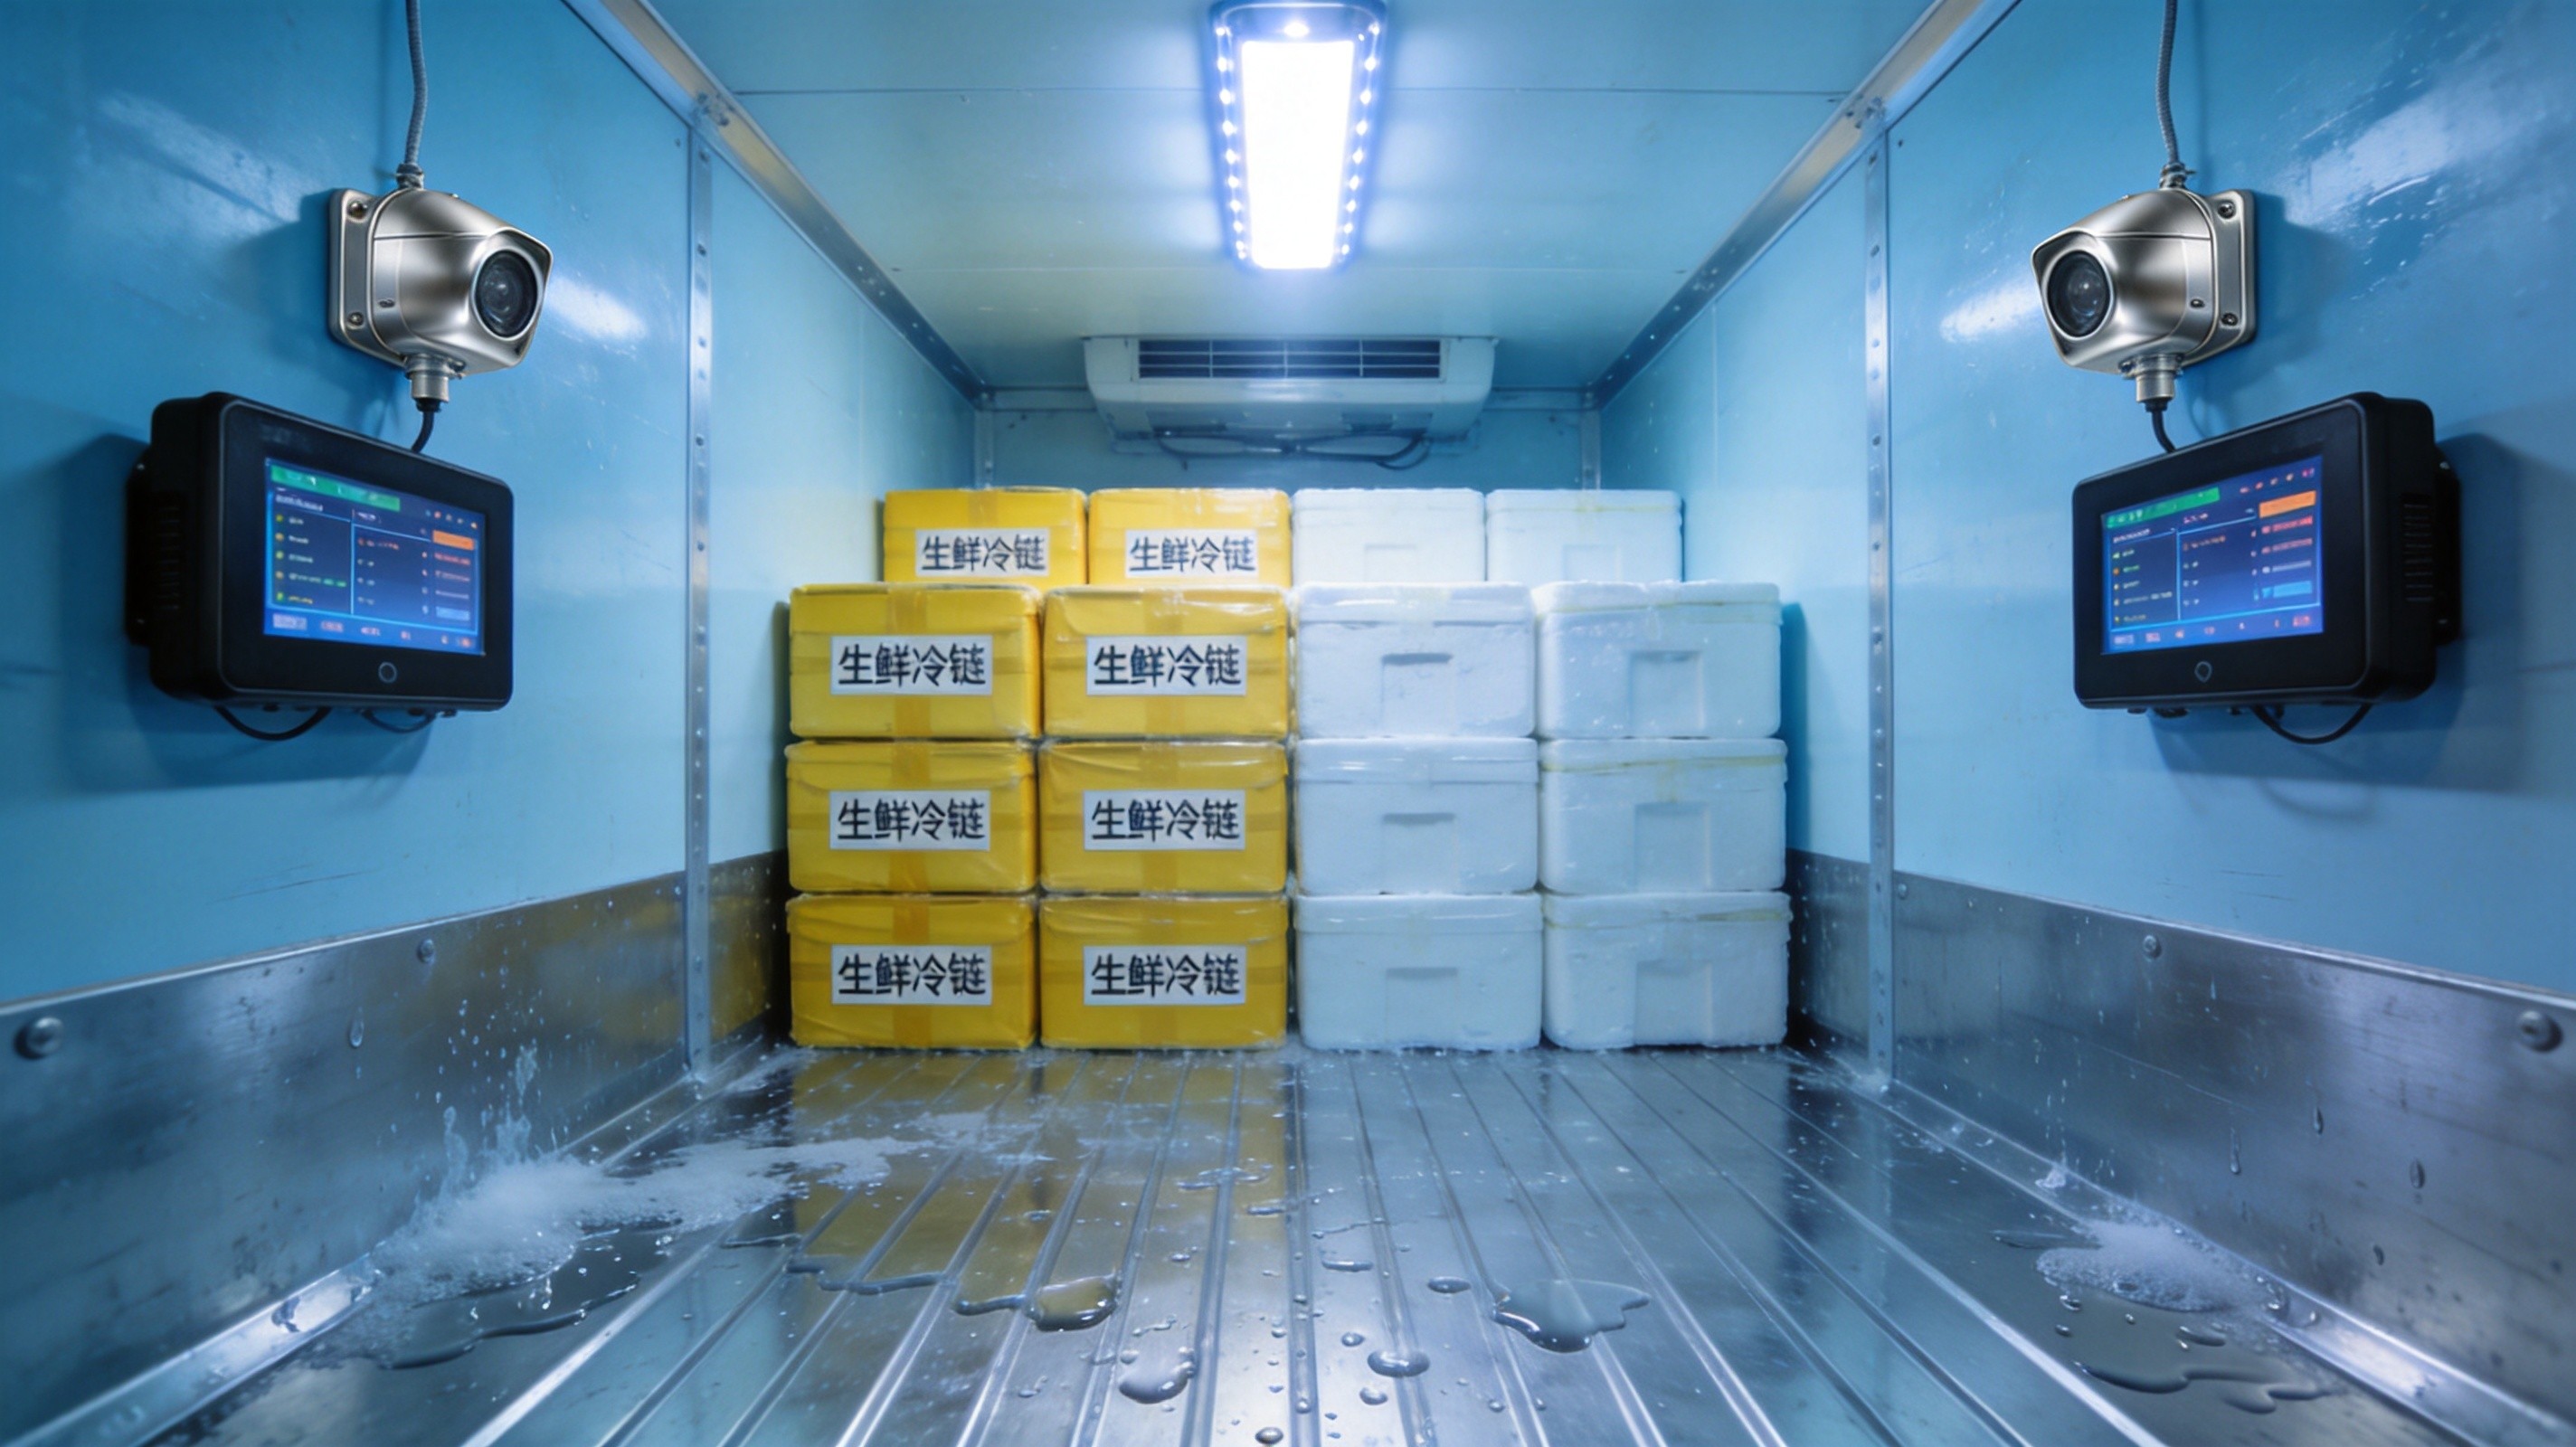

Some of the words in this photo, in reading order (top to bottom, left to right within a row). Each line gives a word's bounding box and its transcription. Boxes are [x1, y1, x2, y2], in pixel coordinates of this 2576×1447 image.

[921, 534, 1045, 572] 生鲜冷链
[1130, 535, 1255, 572] 生鲜冷链
[838, 642, 987, 687] 生鲜冷链
[1093, 642, 1242, 687] 生鲜冷链
[838, 797, 985, 842] 生鲜冷链
[1090, 797, 1240, 842] 生鲜冷链
[838, 951, 987, 998] 生鲜冷链
[1090, 952, 1241, 998] 生鲜冷链
